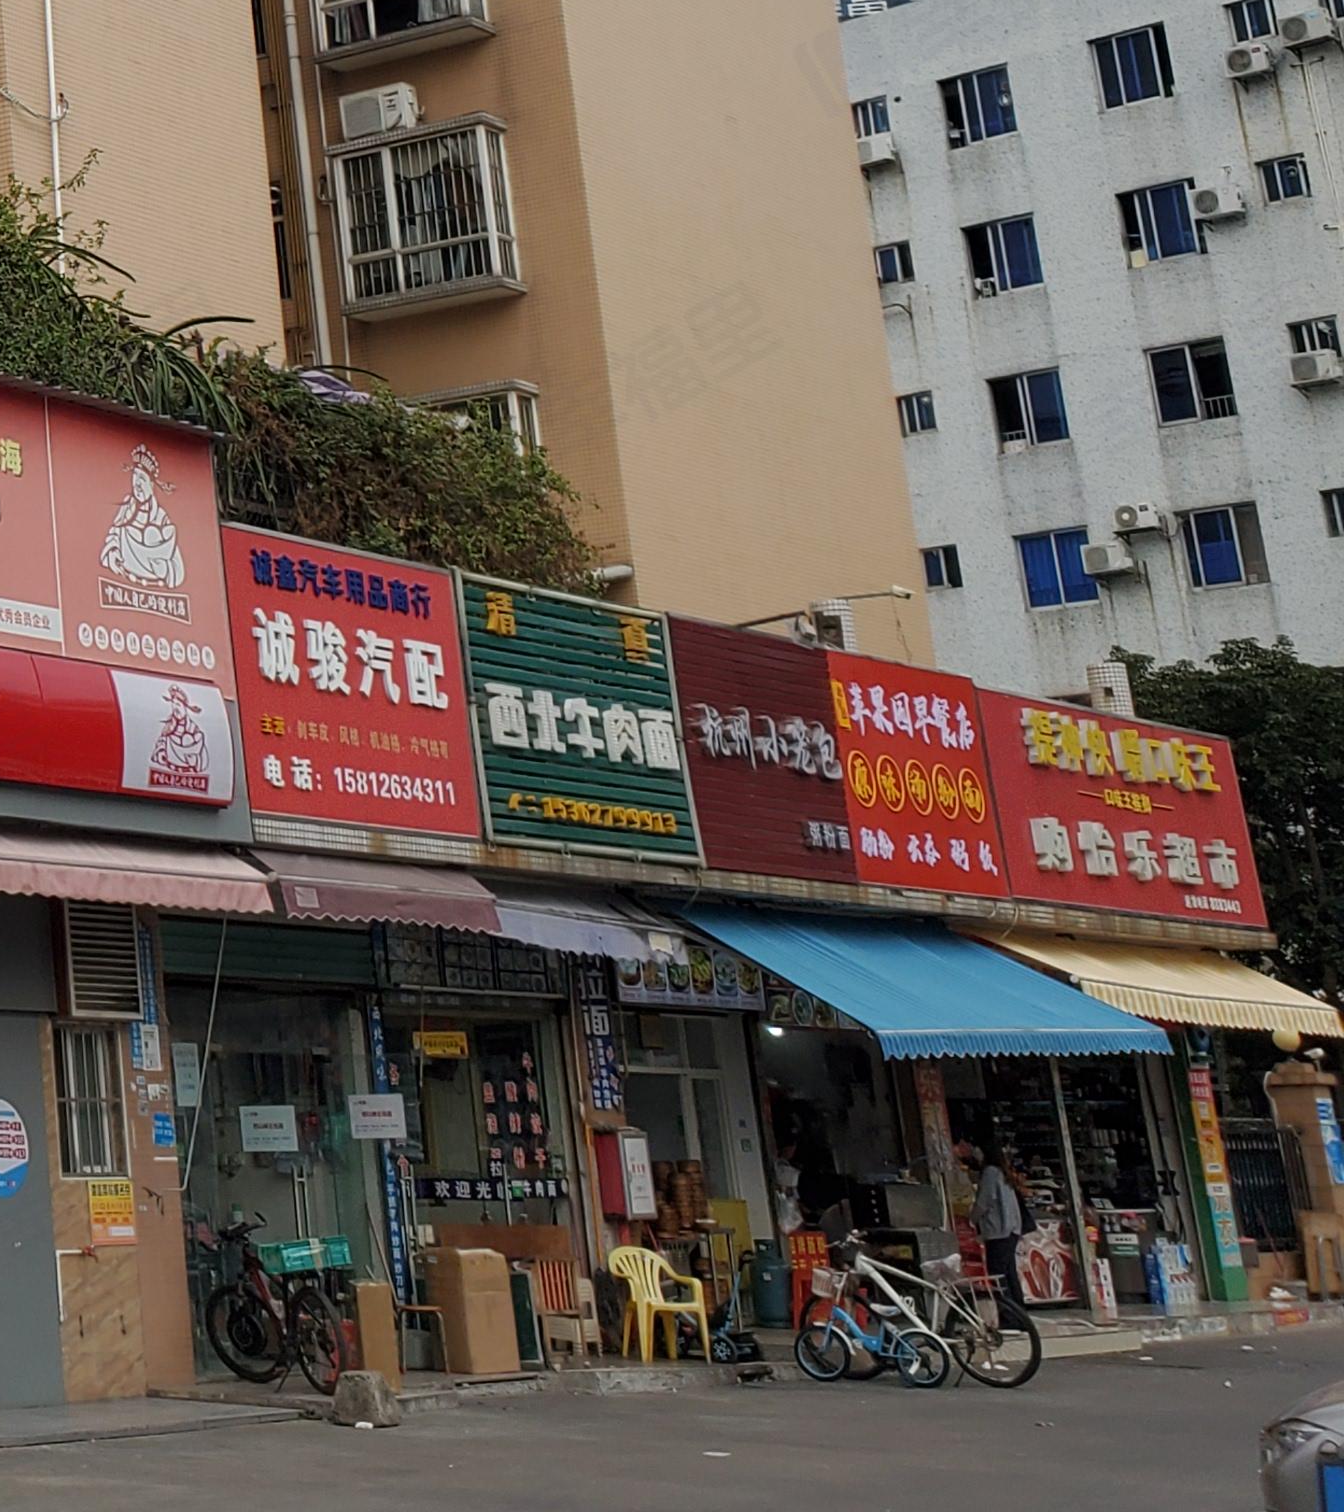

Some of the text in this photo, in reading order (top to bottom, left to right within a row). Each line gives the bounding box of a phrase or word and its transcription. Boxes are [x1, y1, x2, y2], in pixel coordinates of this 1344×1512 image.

[250, 548, 431, 619] 诚鑫汽车用品商行
[252, 607, 450, 710] 诚骏汽配
[484, 682, 681, 772] 西北牛肉面
[1029, 815, 1240, 890] 购怡乐超市
